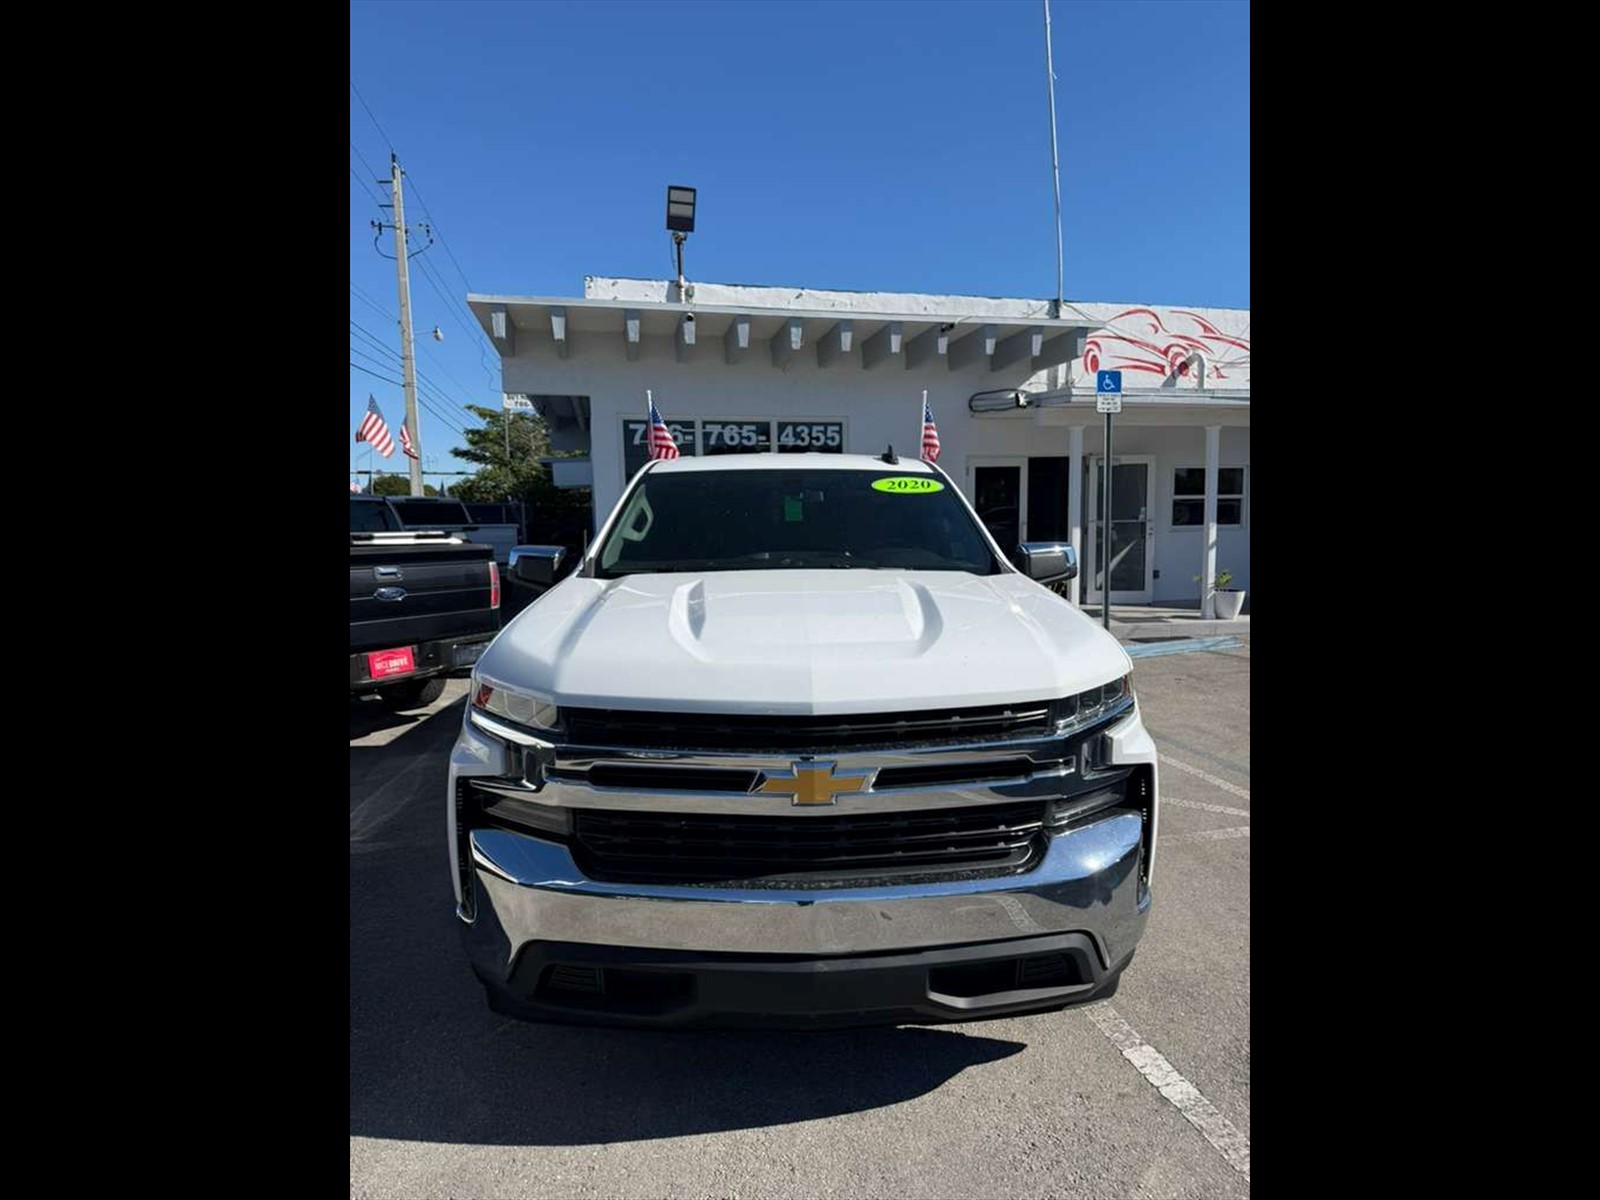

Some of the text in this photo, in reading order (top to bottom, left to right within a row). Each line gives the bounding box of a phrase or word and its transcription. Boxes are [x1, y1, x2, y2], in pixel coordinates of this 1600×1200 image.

[628, 423, 840, 447] 76- 765- 4355
[887, 480, 931, 490] 2020
